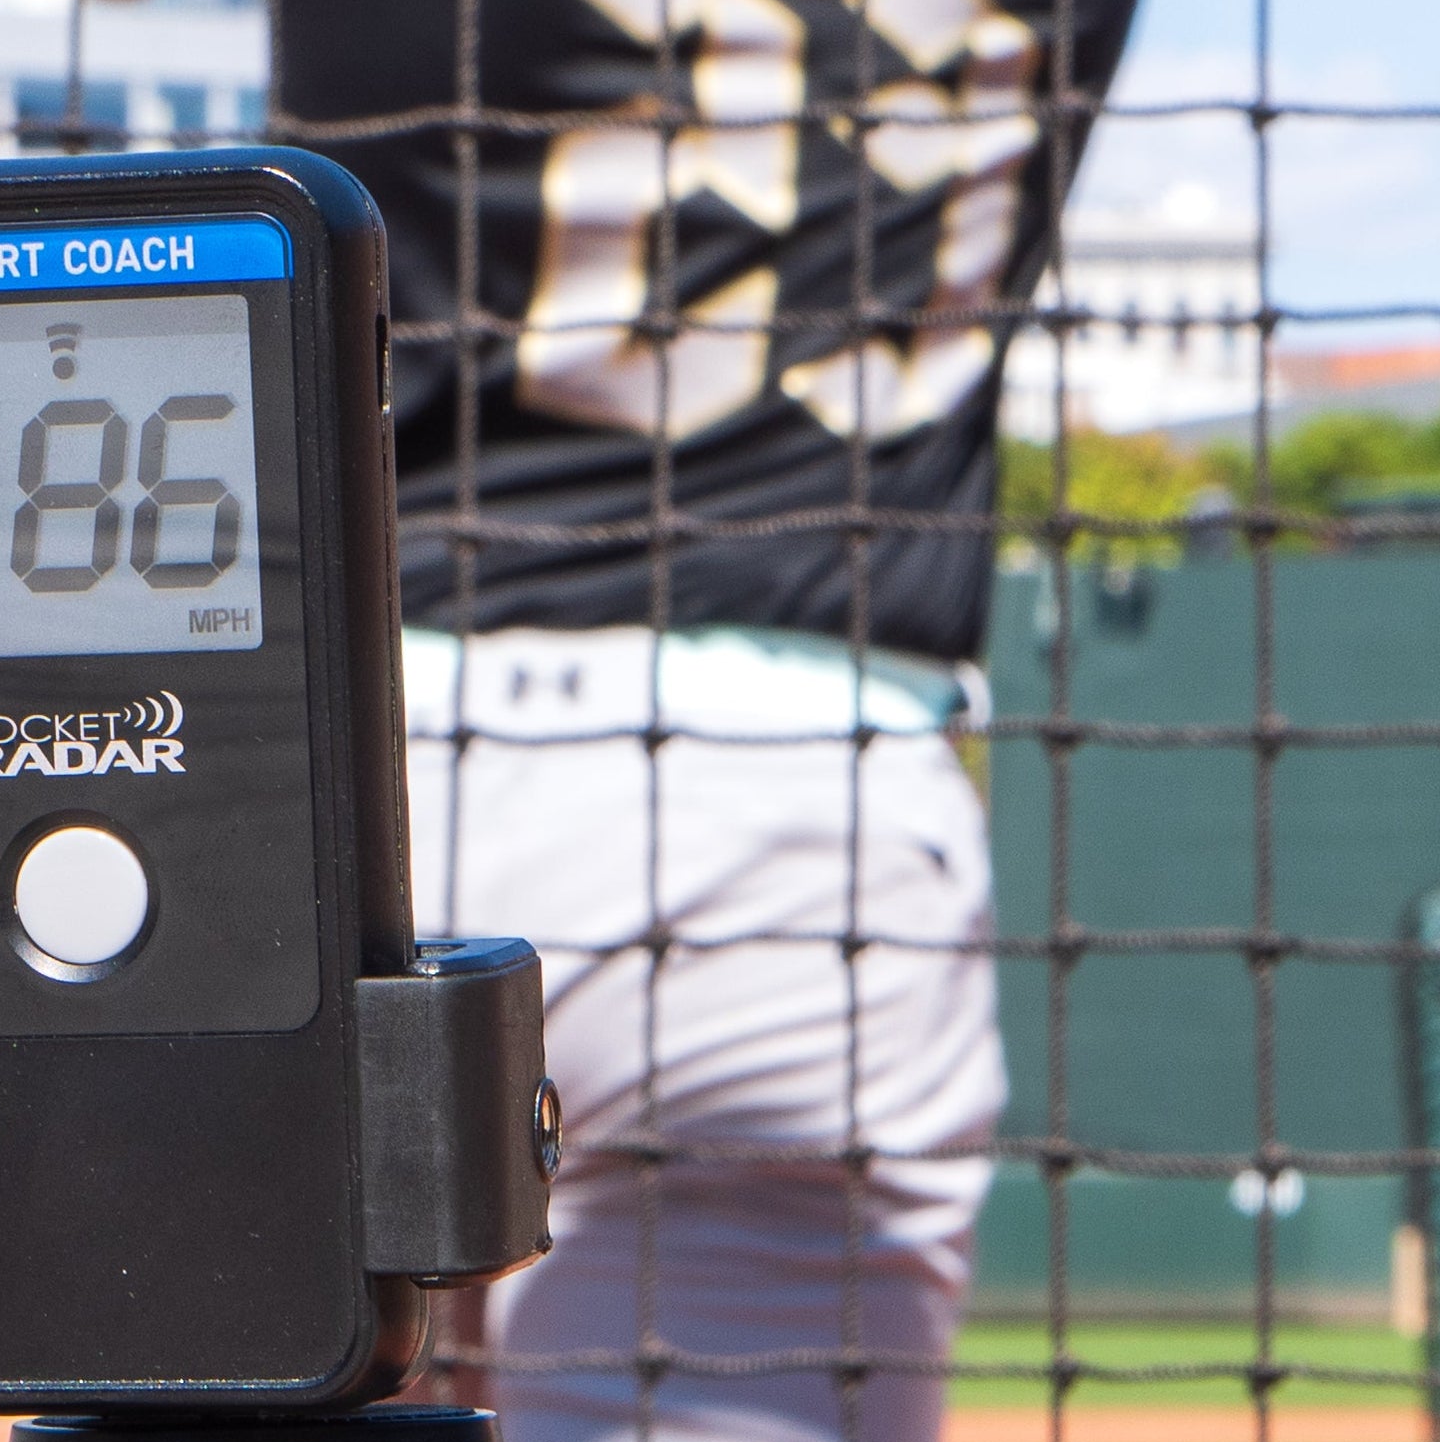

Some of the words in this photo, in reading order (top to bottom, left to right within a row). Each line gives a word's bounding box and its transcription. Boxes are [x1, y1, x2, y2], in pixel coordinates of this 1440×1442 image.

[63, 235, 196, 276] COACH
[9, 393, 242, 594] 86
[188, 608, 252, 635] MPH
